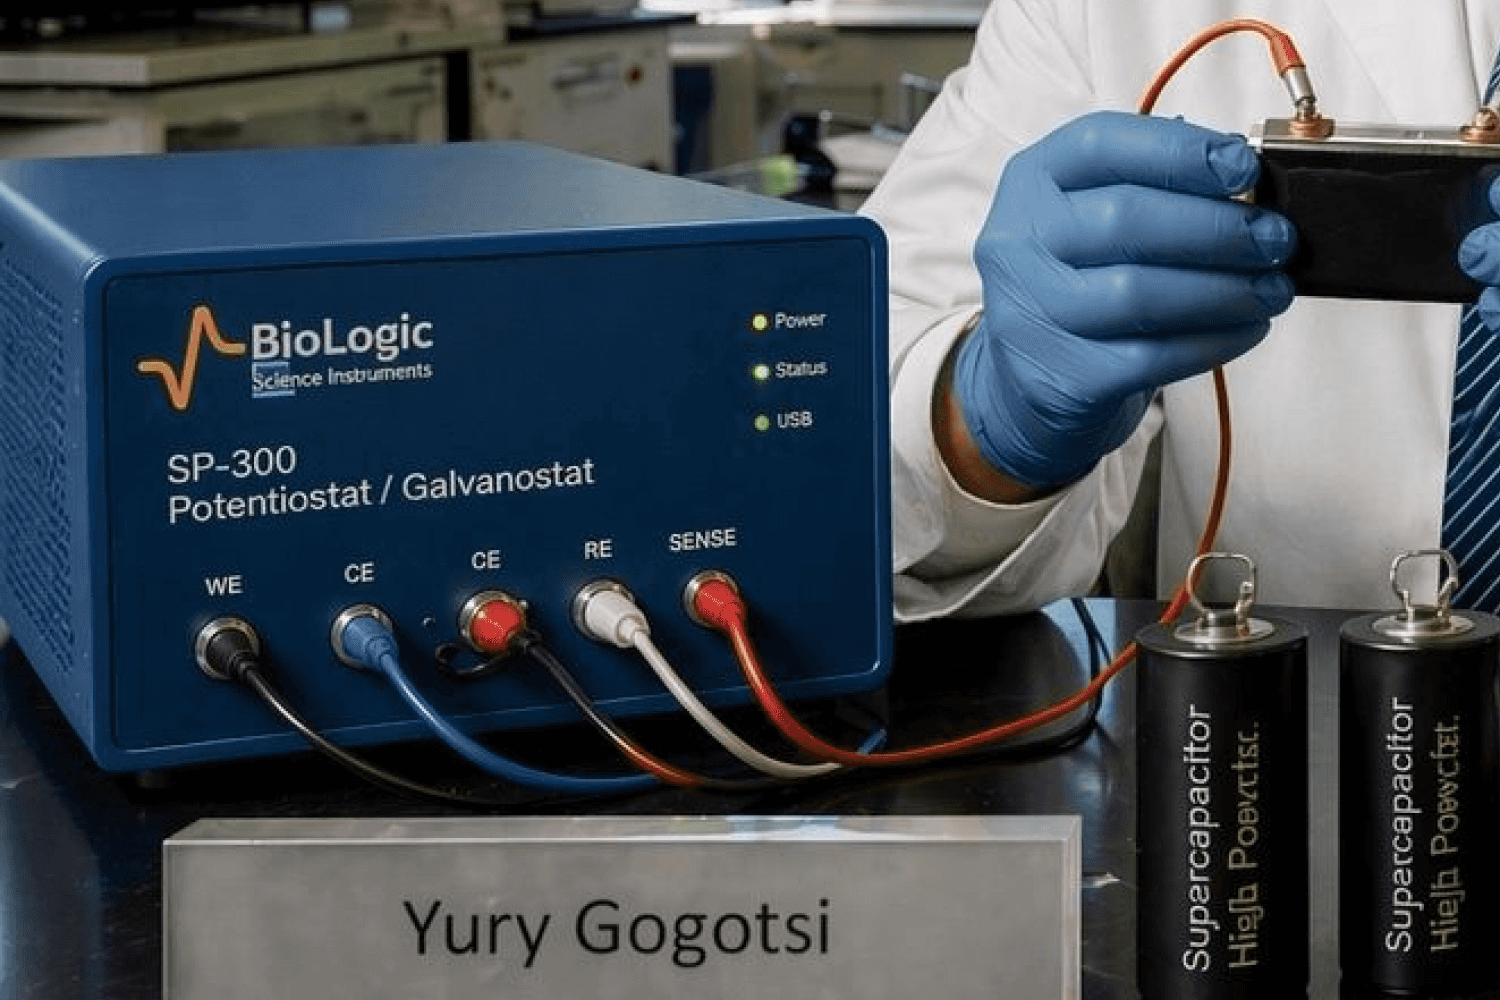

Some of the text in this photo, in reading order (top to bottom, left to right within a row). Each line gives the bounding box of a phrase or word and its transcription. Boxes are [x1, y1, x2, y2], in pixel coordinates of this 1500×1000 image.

[776, 312, 826, 328] Power
[252, 313, 434, 362] BioLogic
[328, 363, 433, 385] Instruments
[776, 362, 827, 378] Status
[778, 412, 812, 428] USB
[170, 446, 295, 482] SP-300
[169, 459, 594, 523] Potentiostat / Galvanostat
[585, 539, 612, 559] RE
[669, 528, 735, 550] SENSE
[472, 550, 499, 569] CE
[345, 562, 374, 582] CE
[206, 575, 241, 595] WE
[404, 899, 828, 968] Yury Gogotsi
